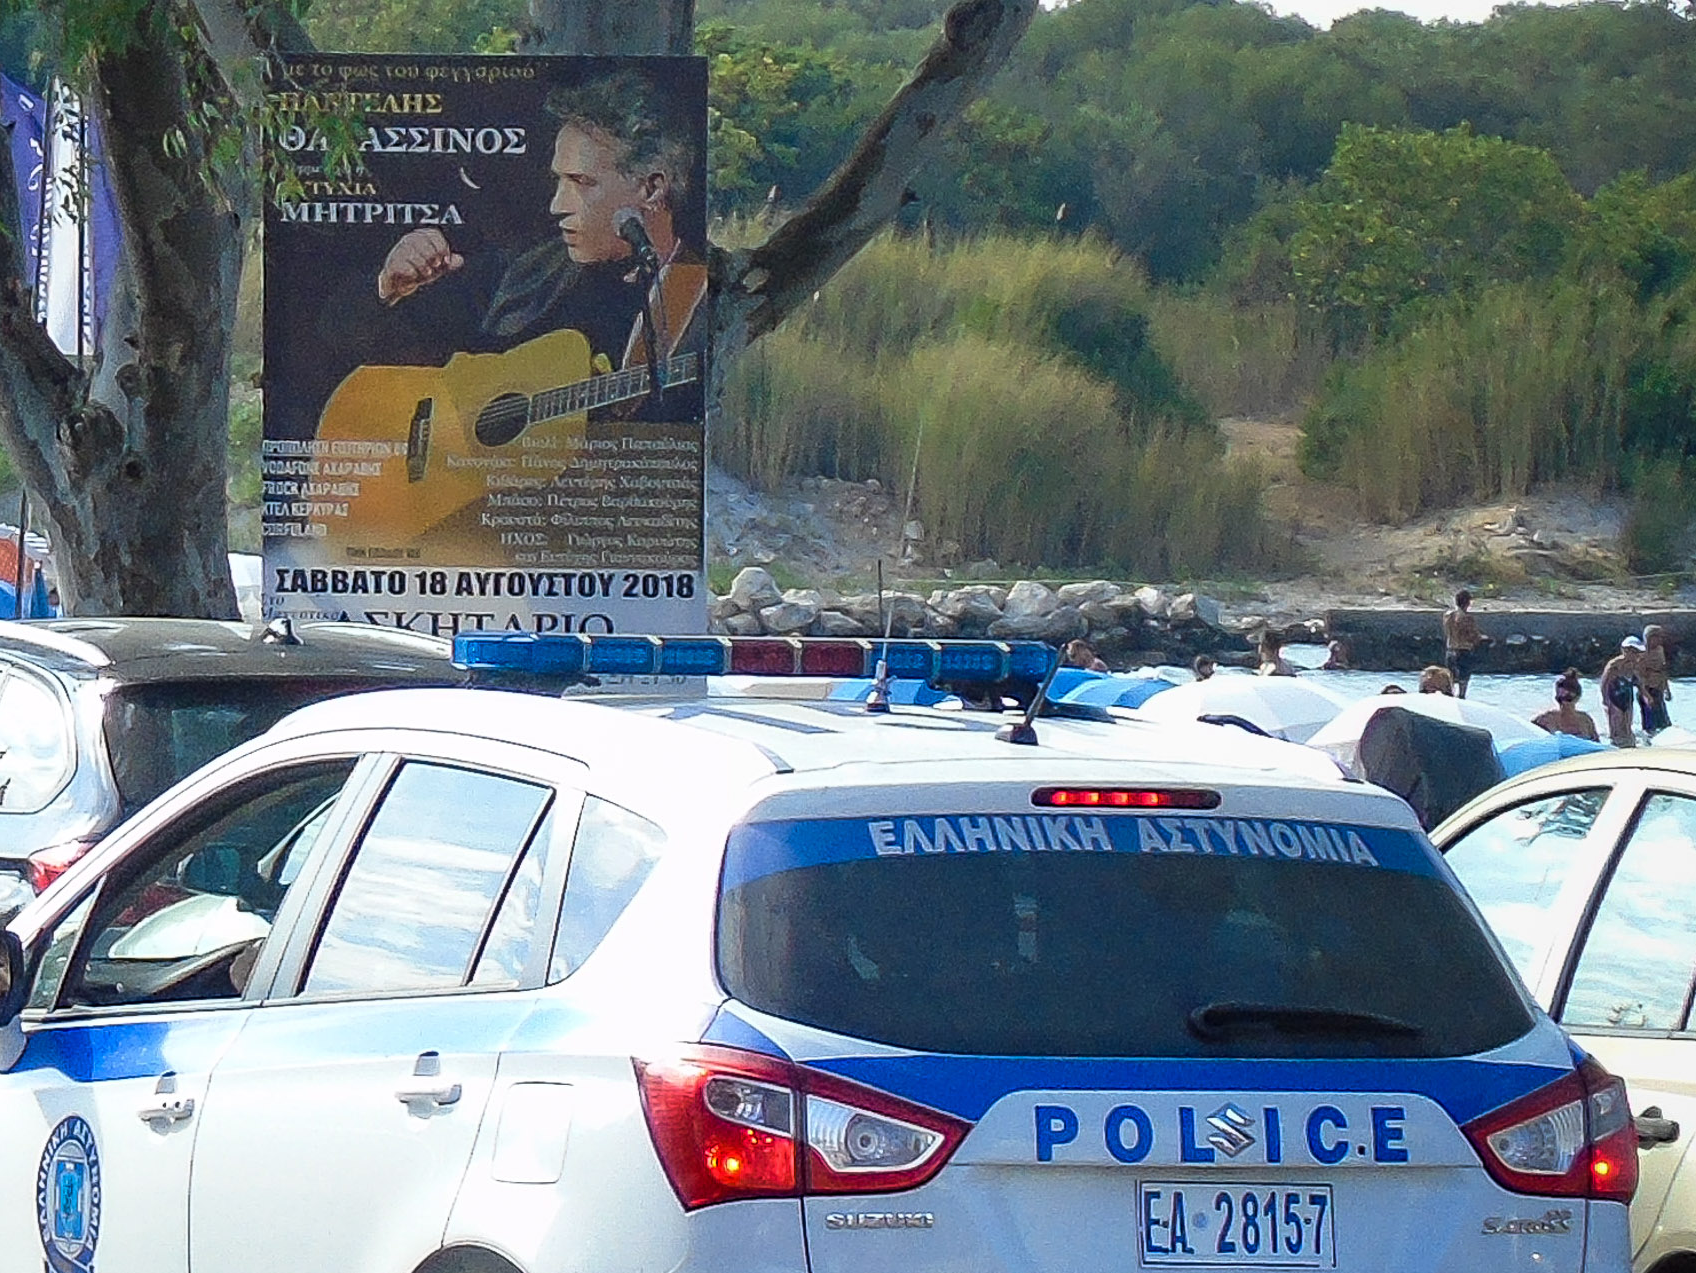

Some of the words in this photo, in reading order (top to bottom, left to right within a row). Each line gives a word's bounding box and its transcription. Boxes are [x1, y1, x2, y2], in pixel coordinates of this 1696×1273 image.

[278, 126, 528, 155] ΘΑΑΣΣΙΝΟΣ
[280, 202, 464, 225] ΜΗΤΡΙΤΣΑ
[275, 569, 407, 596] ΣΑΒΒΑΤΟ
[414, 571, 449, 596] 18
[454, 570, 613, 599] ΑΥΓΟΥΣΤΟΥ
[621, 574, 696, 600] 2018
[867, 815, 1113, 857] ΕΛΛΗΝΙΚΗ
[1137, 816, 1381, 868] ΑΣΤΥΝΟΜΙΑ
[1035, 1104, 1409, 1164] POLICE
[1213, 1190, 1329, 1256] 28157
